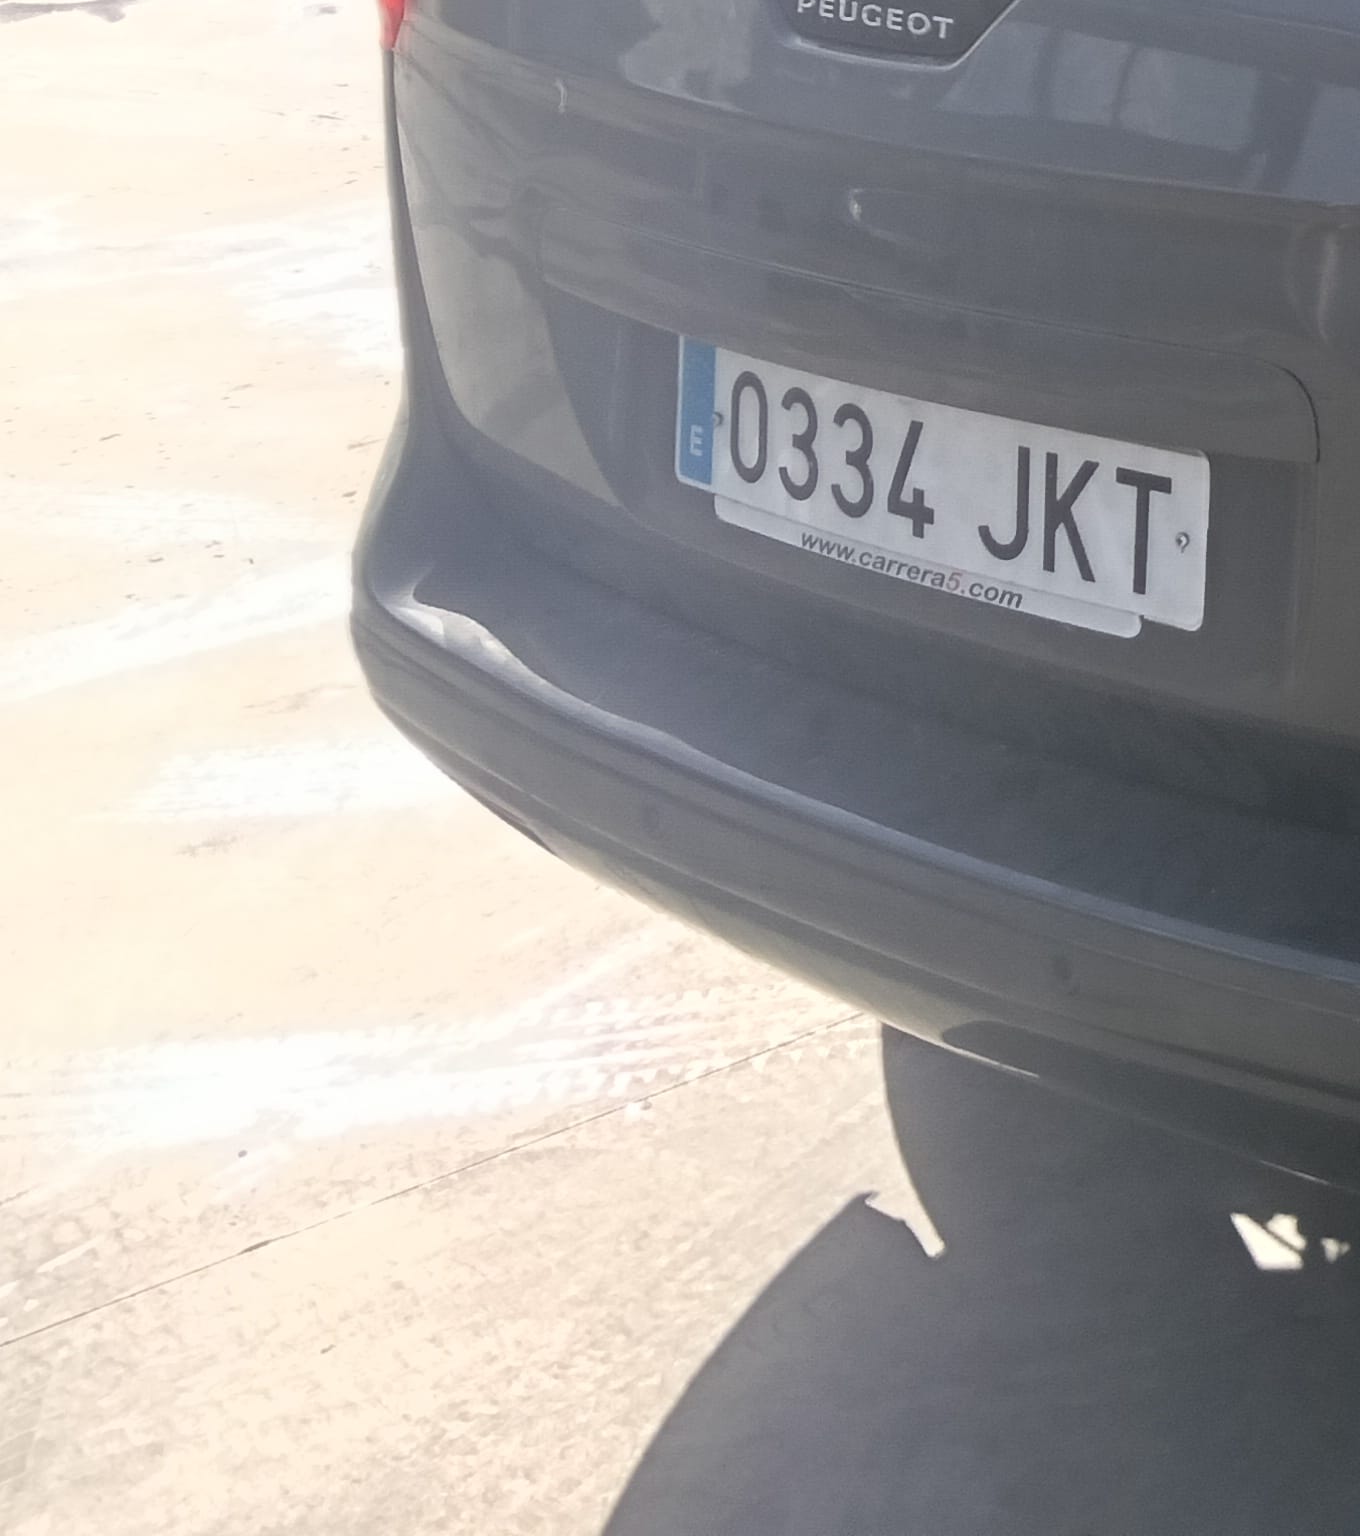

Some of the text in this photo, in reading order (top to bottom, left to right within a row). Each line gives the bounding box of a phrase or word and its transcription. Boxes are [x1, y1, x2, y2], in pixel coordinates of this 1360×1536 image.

[729, 370, 1173, 595] 0334 JKT
[800, 530, 1024, 609] www.carrera5.com
